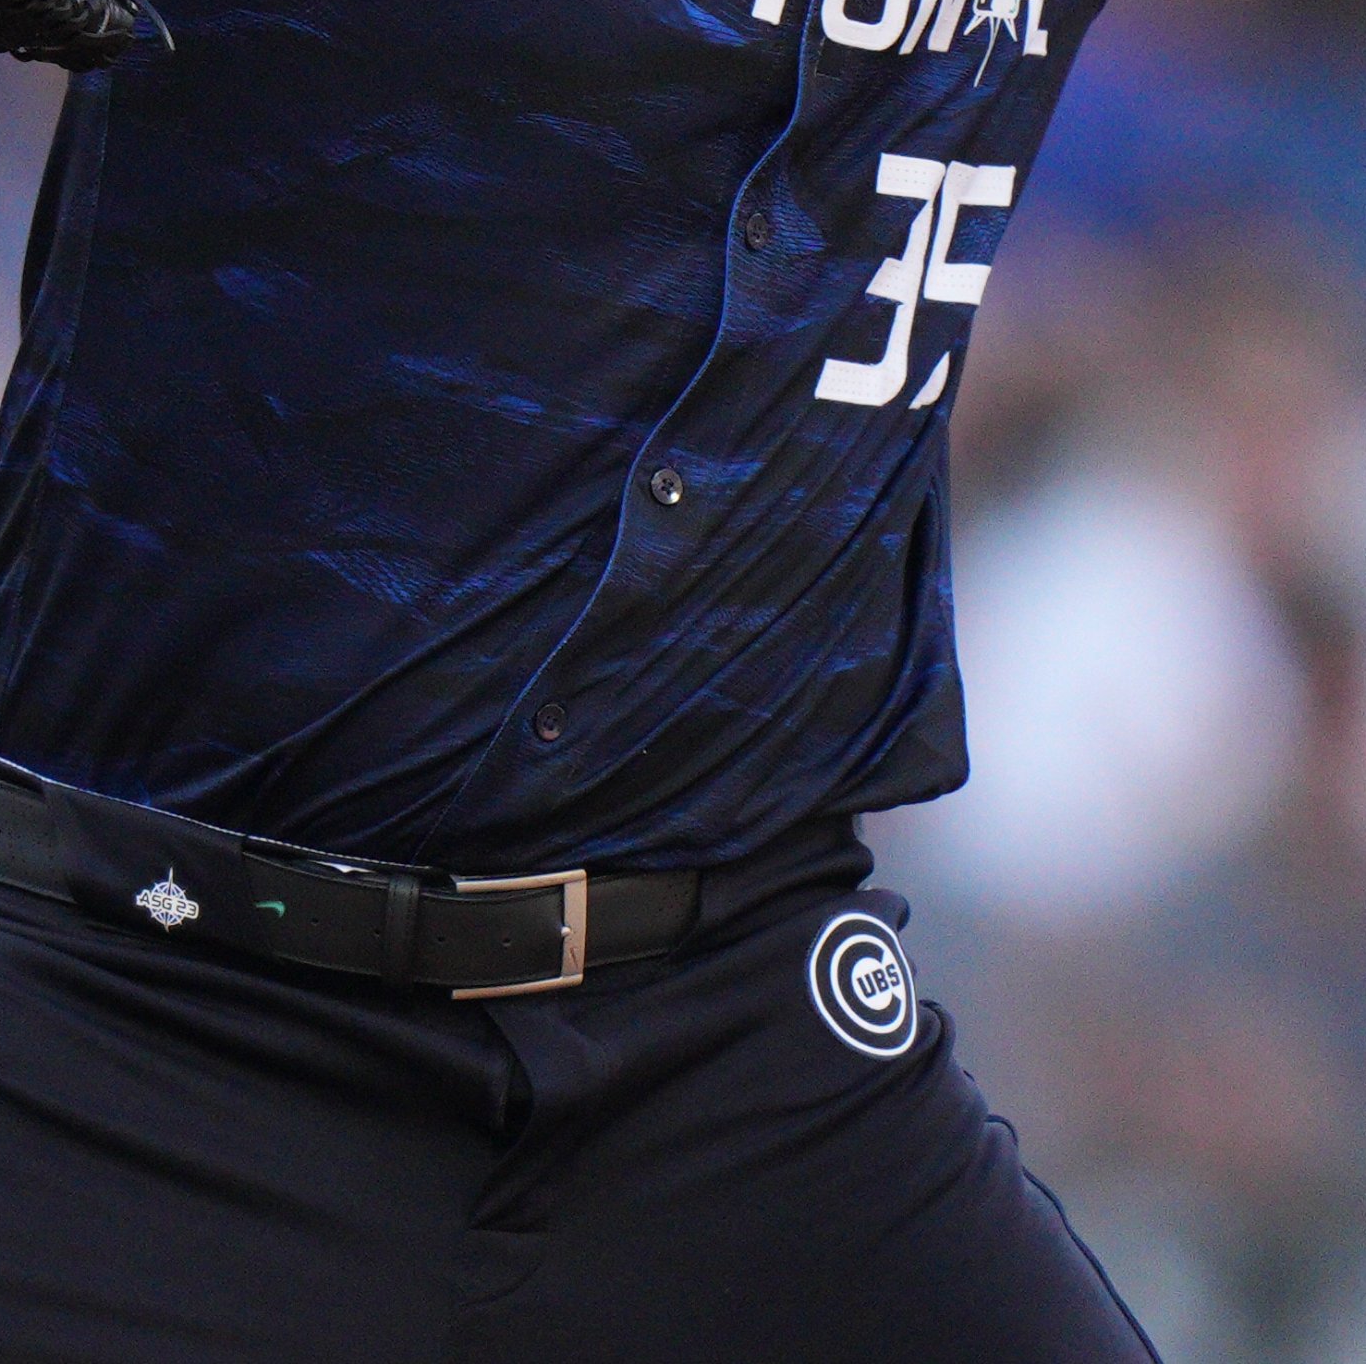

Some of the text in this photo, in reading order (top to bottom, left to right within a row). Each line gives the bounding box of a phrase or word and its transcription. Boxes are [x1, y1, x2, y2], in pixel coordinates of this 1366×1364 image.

[813, 152, 1016, 410] 35
[138, 890, 198, 918] ASG 23
[829, 933, 907, 1035] CUBS
